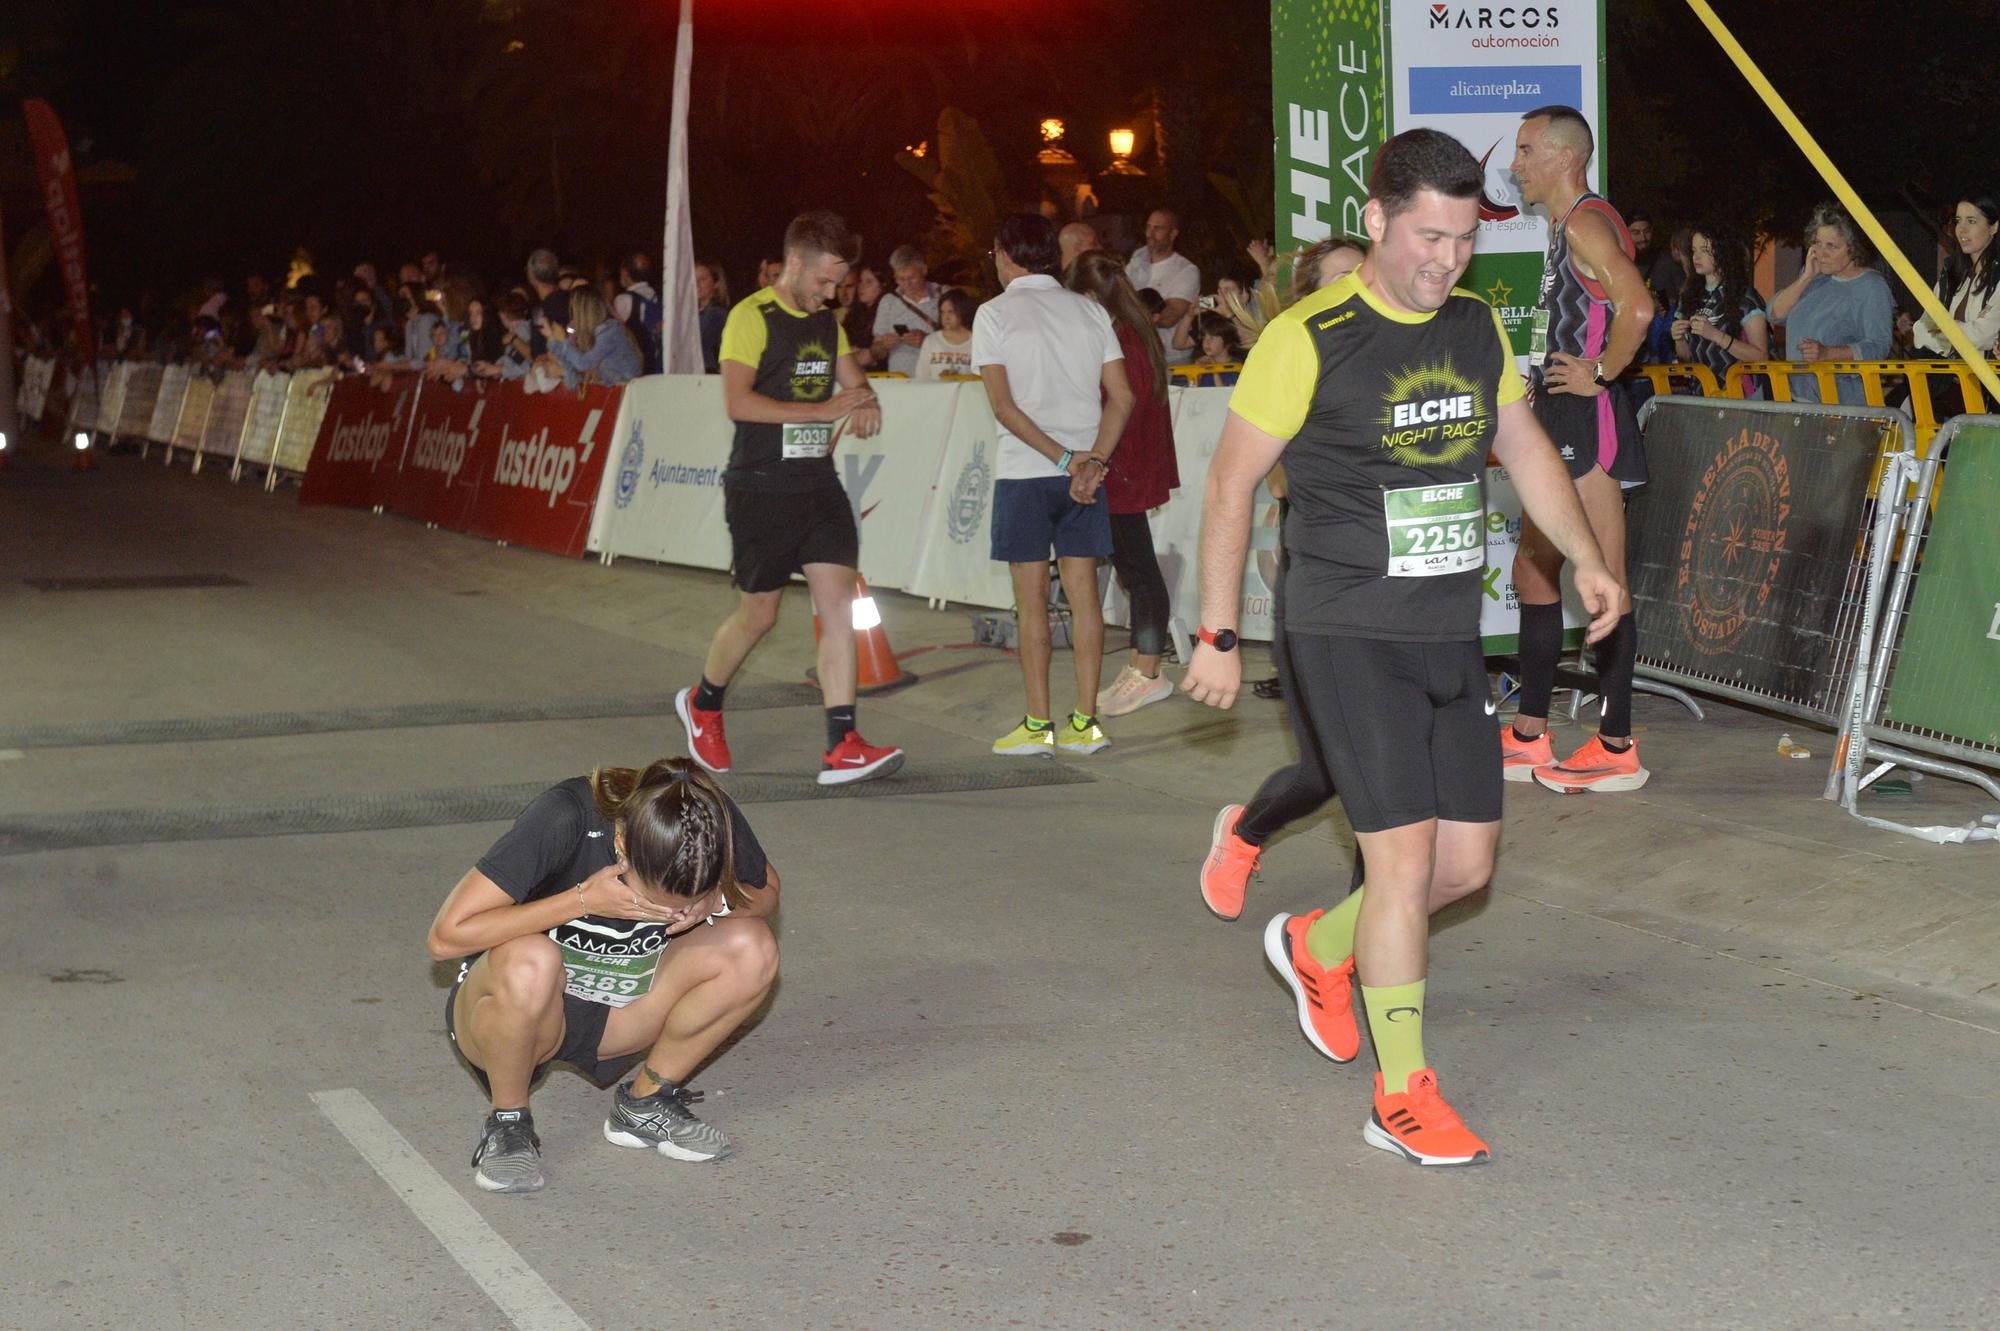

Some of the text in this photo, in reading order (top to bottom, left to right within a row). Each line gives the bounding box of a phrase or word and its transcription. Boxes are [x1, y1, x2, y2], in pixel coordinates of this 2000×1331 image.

[1430, 4, 1558, 28] MARCOS
[1472, 34, 1559, 48] automoción
[1450, 80, 1541, 99] alicanteplaza
[1394, 395, 1472, 428] ELCHE
[328, 411, 390, 472] lastlap
[793, 429, 828, 444] 2038
[1381, 420, 1487, 448] NIGHT RACE
[414, 415, 467, 487] lastlap
[494, 424, 575, 508] lastlap
[649, 458, 717, 490] Ajuntament
[1422, 487, 1464, 502] ELCHE
[1406, 522, 1476, 553] 2256
[586, 954, 632, 967] ELCHE
